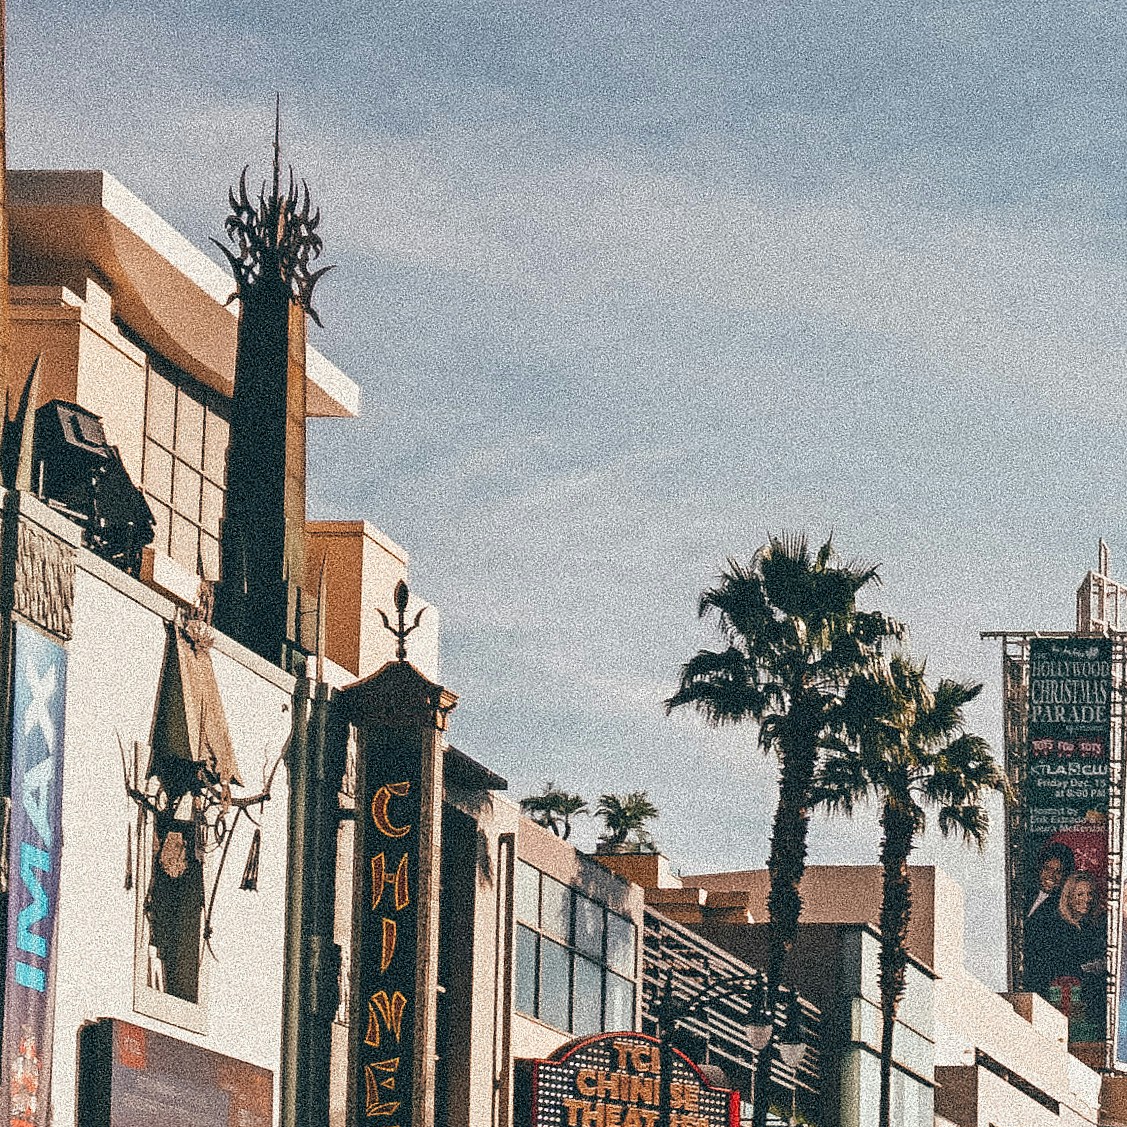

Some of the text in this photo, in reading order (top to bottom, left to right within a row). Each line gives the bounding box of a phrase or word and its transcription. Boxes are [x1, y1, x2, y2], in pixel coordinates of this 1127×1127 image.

[1031, 660, 1110, 678] HOLLYWOOD
[1031, 679, 1108, 705] CHRISTMAS
[1031, 705, 1107, 724] PARADE
[15, 660, 58, 994] IMAX
